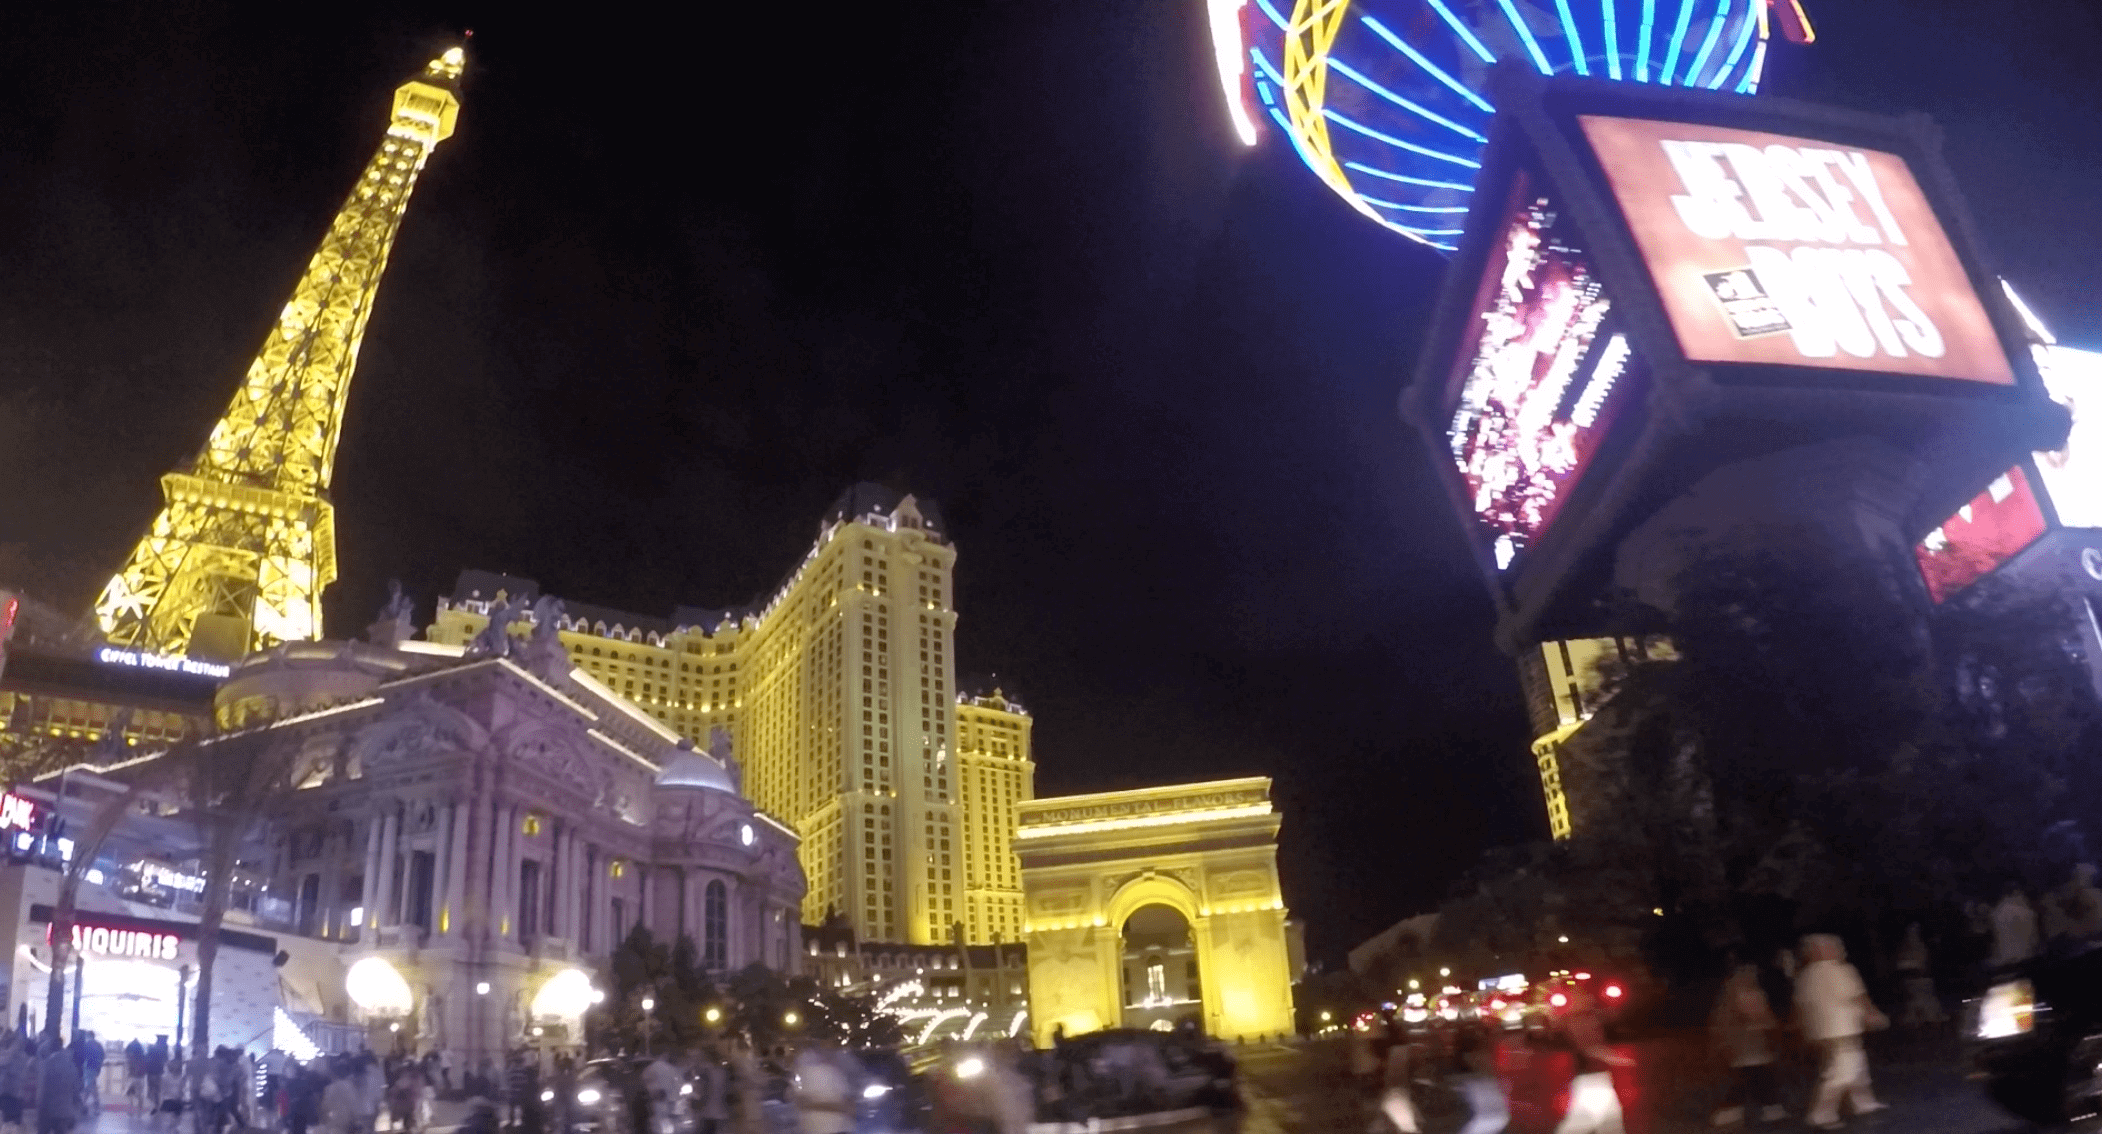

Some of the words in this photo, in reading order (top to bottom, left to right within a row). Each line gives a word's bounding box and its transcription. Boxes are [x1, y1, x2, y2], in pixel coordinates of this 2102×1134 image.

[1659, 139, 1909, 246] JERSEY
[1744, 246, 1946, 358] BOYS
[100, 648, 138, 667] EIFFEL
[141, 652, 179, 671] TOWER
[46, 921, 178, 961] AIQUIRIS
